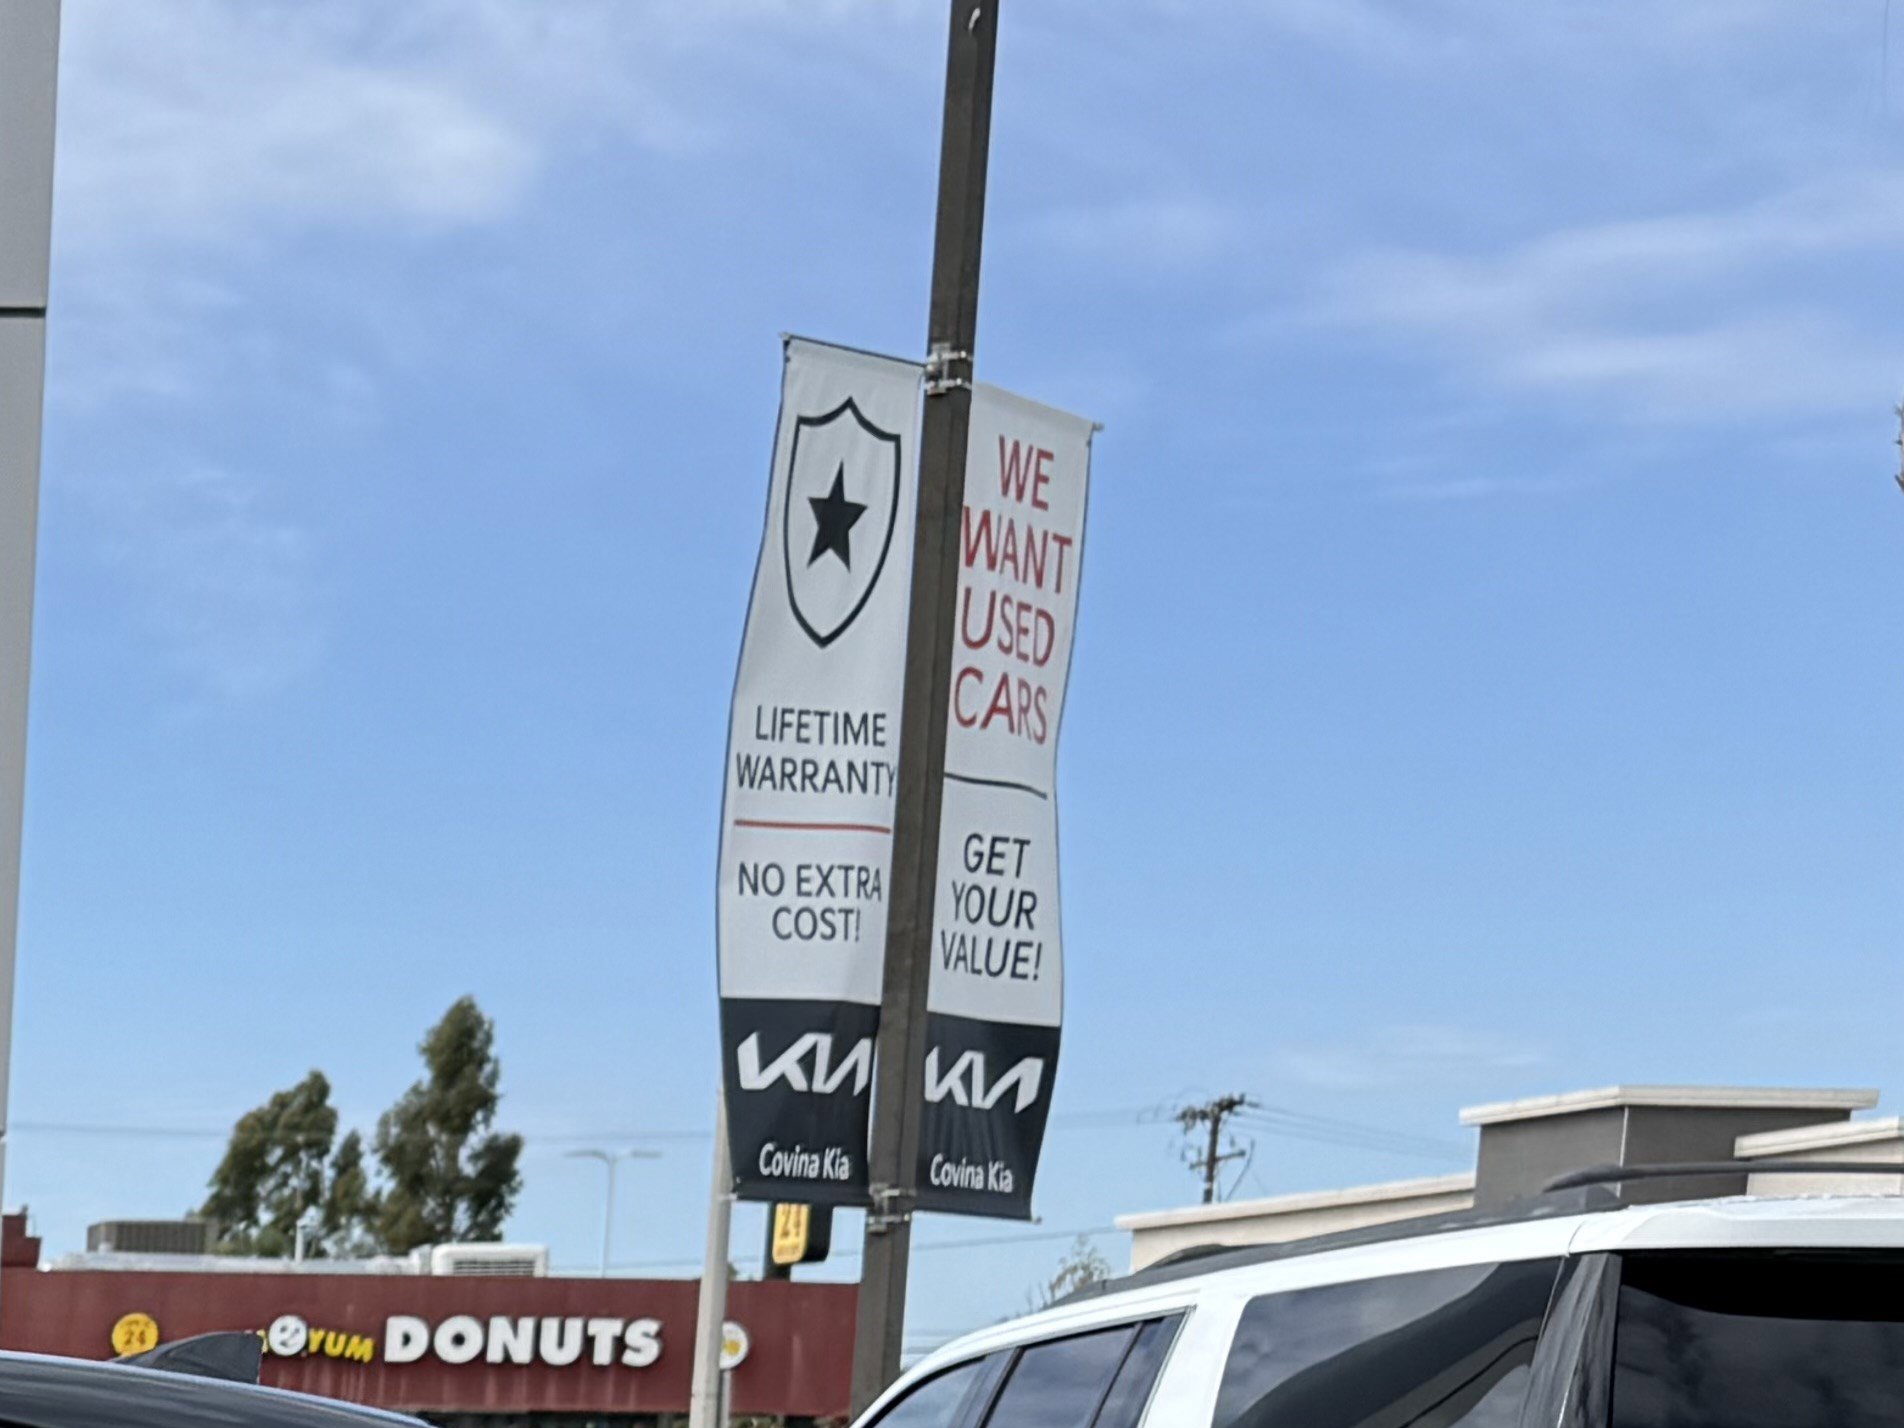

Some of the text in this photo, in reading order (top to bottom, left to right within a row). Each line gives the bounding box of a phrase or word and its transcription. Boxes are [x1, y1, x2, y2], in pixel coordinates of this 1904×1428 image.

[999, 434, 1054, 511] WE
[963, 505, 1072, 595] WANT
[961, 587, 1056, 668] USED
[754, 704, 888, 748] LIFETIME
[954, 667, 1048, 745] CARS
[735, 752, 896, 798] WARRANTY
[963, 833, 1031, 880] GET
[737, 862, 882, 902] NO EXTRA
[951, 881, 1037, 931] YOUR
[771, 907, 862, 943] COST!
[940, 929, 1043, 982] VALUE!
[759, 1142, 850, 1181] Covina Kia
[930, 1153, 1013, 1194] Covina Kia
[308, 1328, 375, 1364] YUM
[383, 1315, 663, 1367] DONUTS
